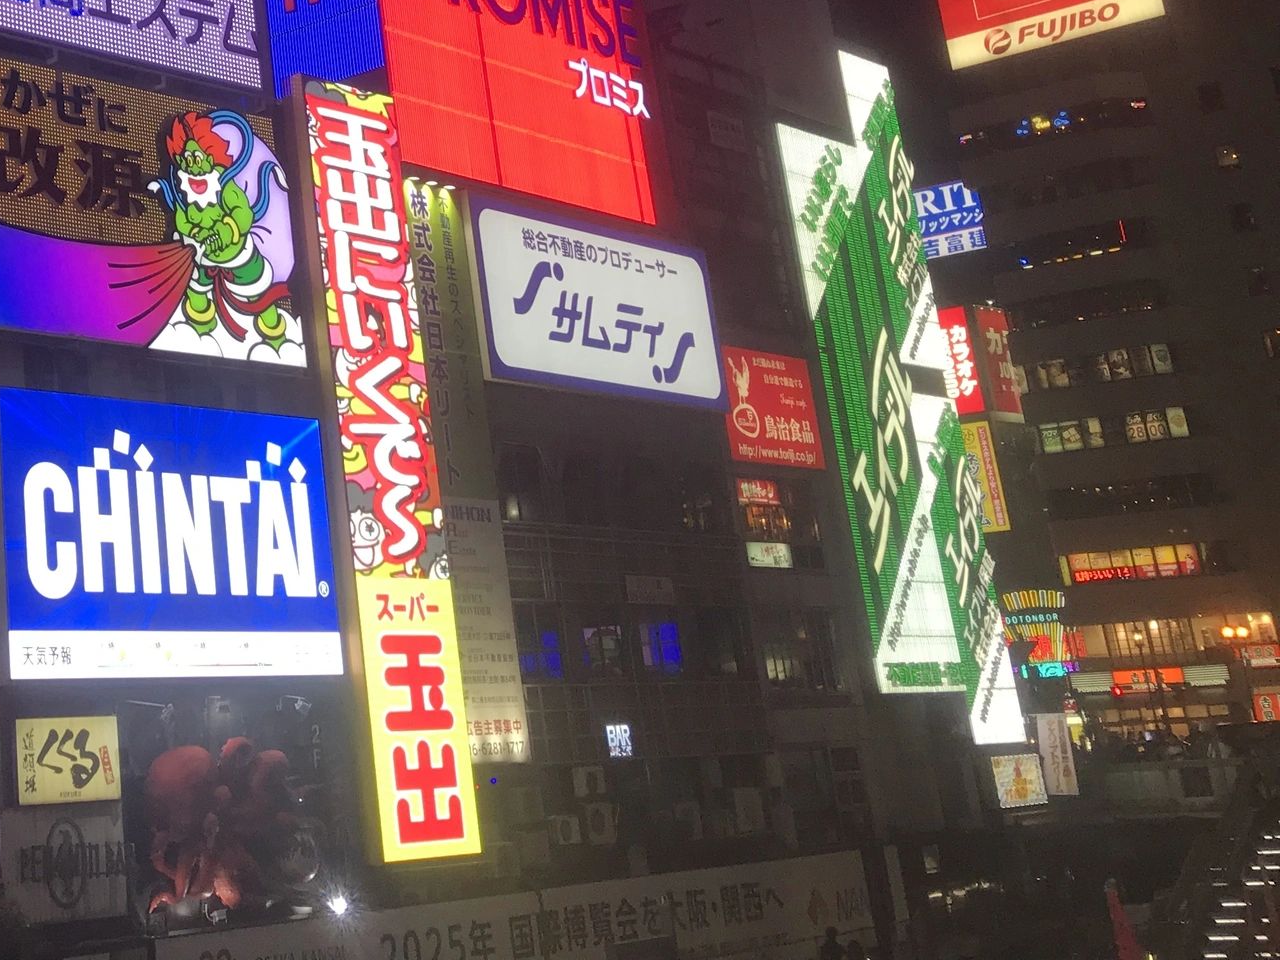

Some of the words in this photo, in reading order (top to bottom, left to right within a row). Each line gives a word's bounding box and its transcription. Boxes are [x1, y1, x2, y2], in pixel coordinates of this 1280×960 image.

[1018, 2, 1120, 42] FUJIBO
[1, 69, 128, 134] かぜに
[568, 57, 651, 118] プロミス
[521, 228, 678, 279] 総合不動産のプロデューサー
[949, 325, 978, 397] カラオケ
[23, 430, 318, 599] CHINTAI
[375, 593, 439, 621] スーパー
[22, 646, 72, 665] 天気予報
[380, 634, 464, 844] 玉出
[469, 741, 525, 757] 6-6281-1717
[606, 725, 631, 746] BAR
